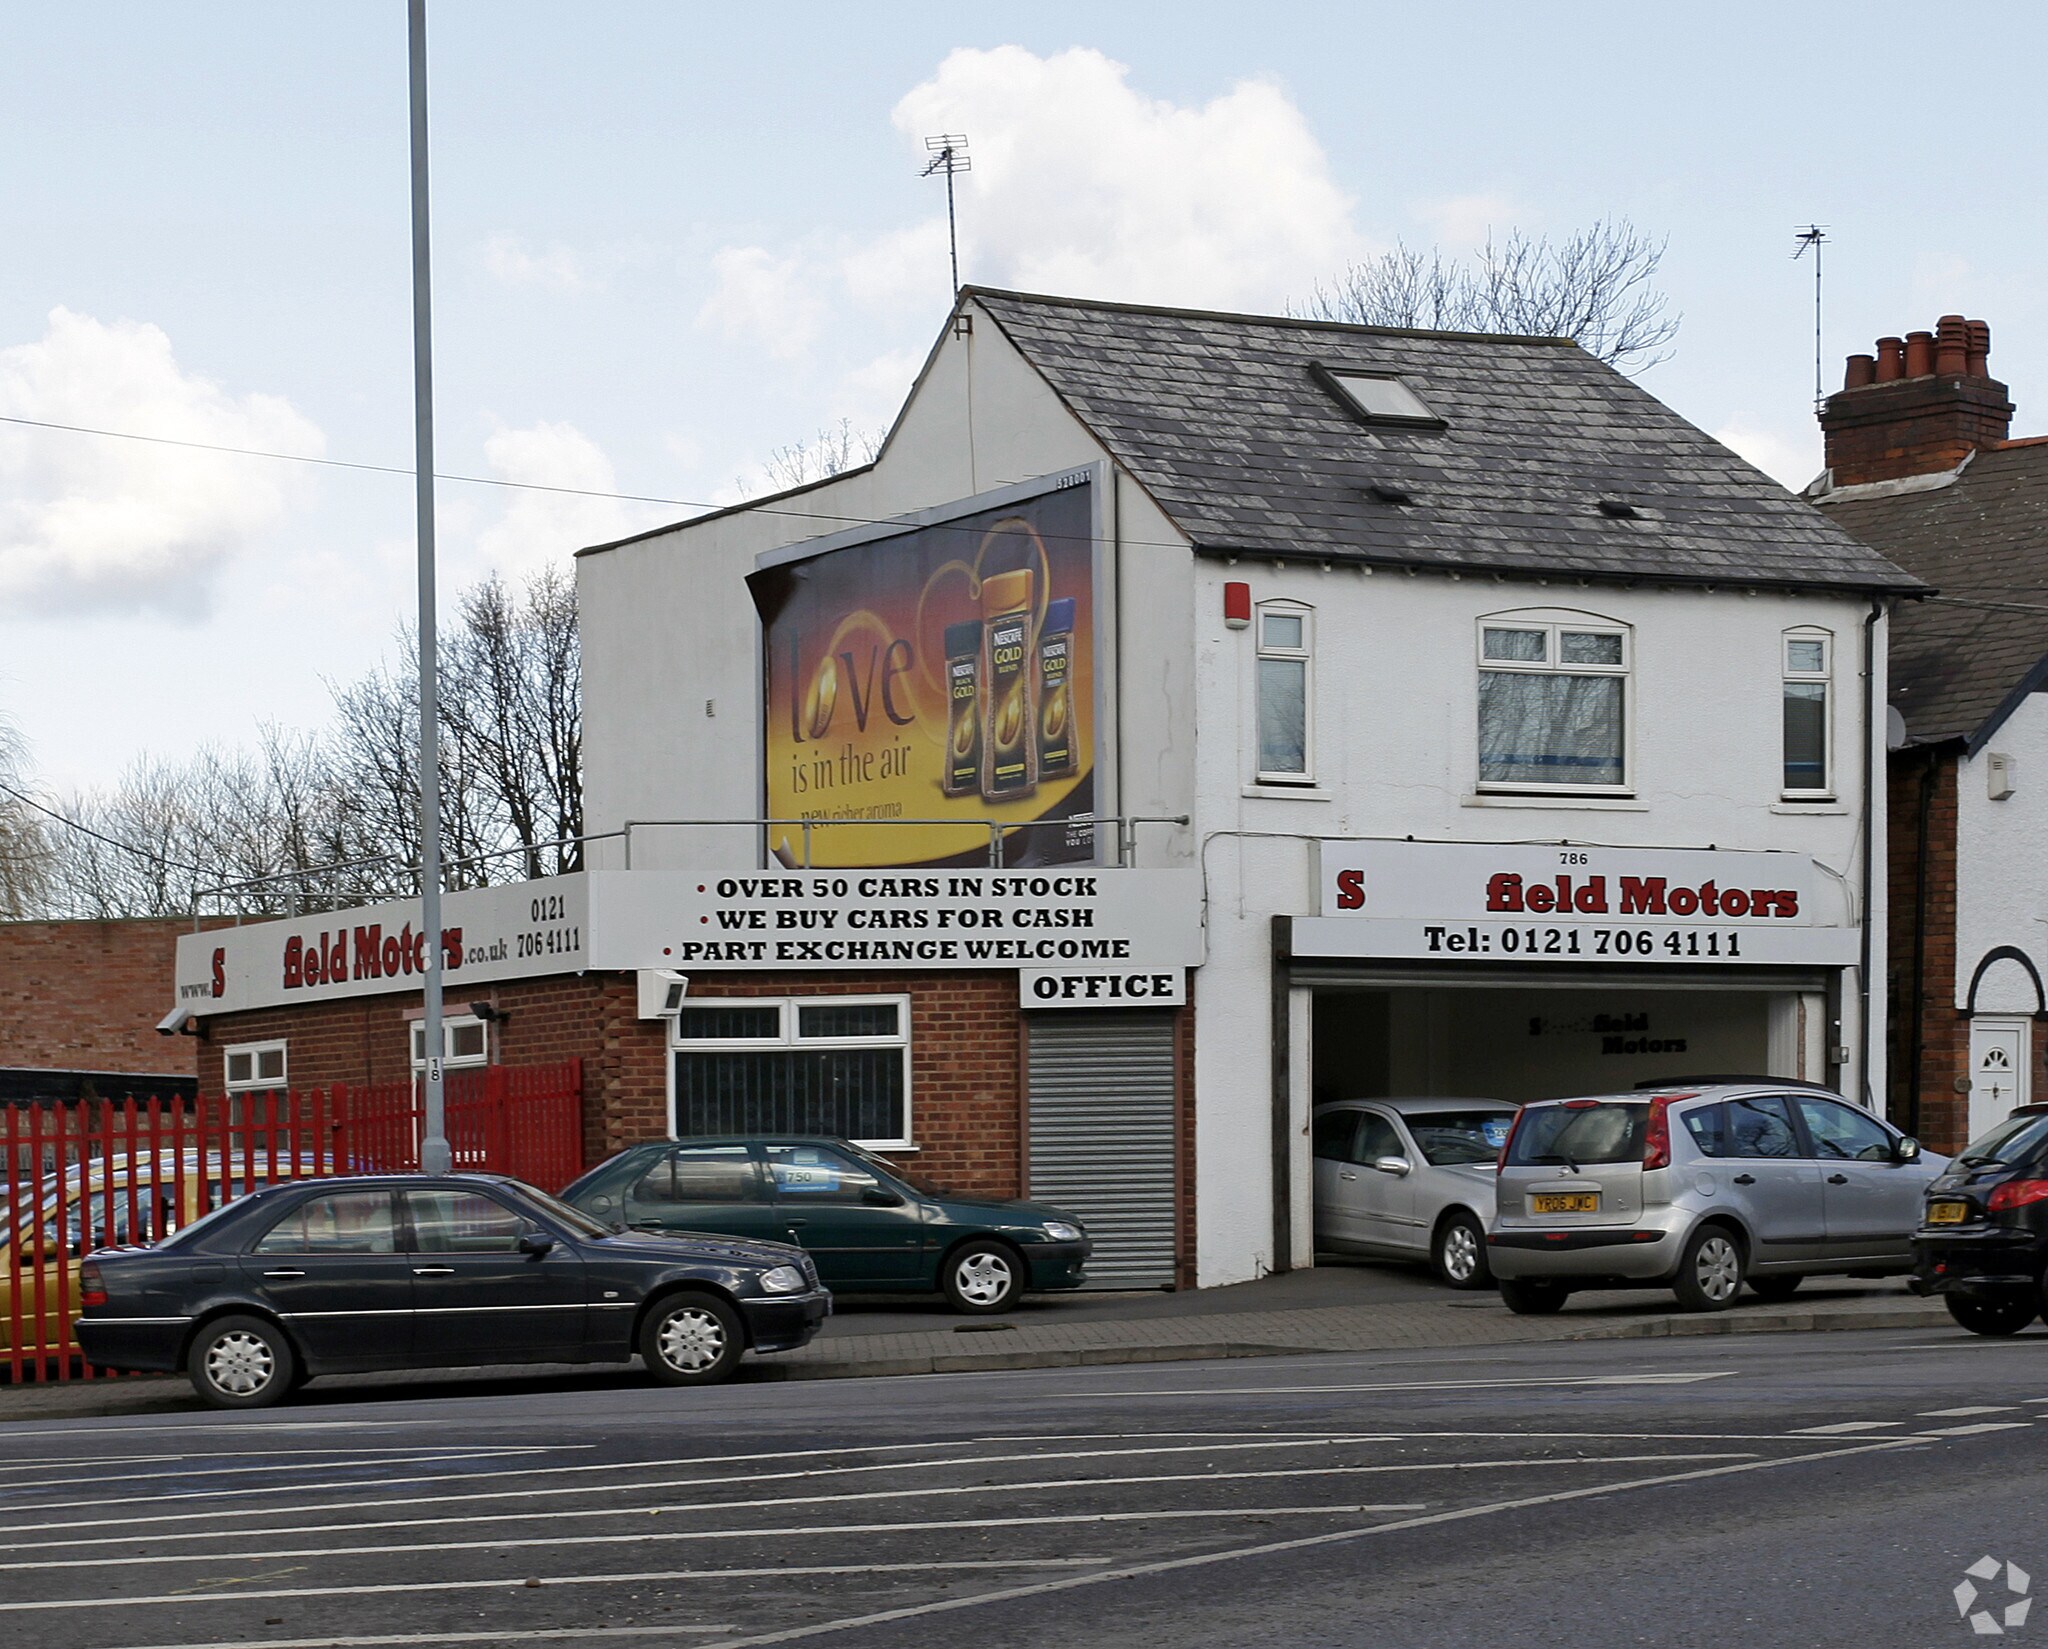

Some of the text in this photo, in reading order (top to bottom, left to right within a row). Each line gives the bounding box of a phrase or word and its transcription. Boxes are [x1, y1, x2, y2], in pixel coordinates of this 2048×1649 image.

[994, 646, 1022, 664] GOLD
[1043, 657, 1066, 672] GOLD
[953, 685, 975, 699] GOLD
[792, 735, 912, 793] is in the air
[800, 808, 832, 831] new
[866, 801, 903, 821] aroma
[1559, 852, 1588, 865] 786
[716, 878, 1098, 898] OVER 50 CARS IN STOCK
[1337, 869, 1799, 918] S field Motors
[531, 894, 565, 922] 0121
[716, 909, 1095, 929] WE BUY CARS FOR CASH
[517, 926, 580, 958] 706 4111
[682, 939, 1131, 961] PART EXCHANGE WELCOME
[1424, 926, 1740, 957] Tel: 0121 706 4111
[284, 930, 347, 990] field
[1033, 974, 1174, 999] OFFICE
[1601, 1036, 1687, 1055] Motors
